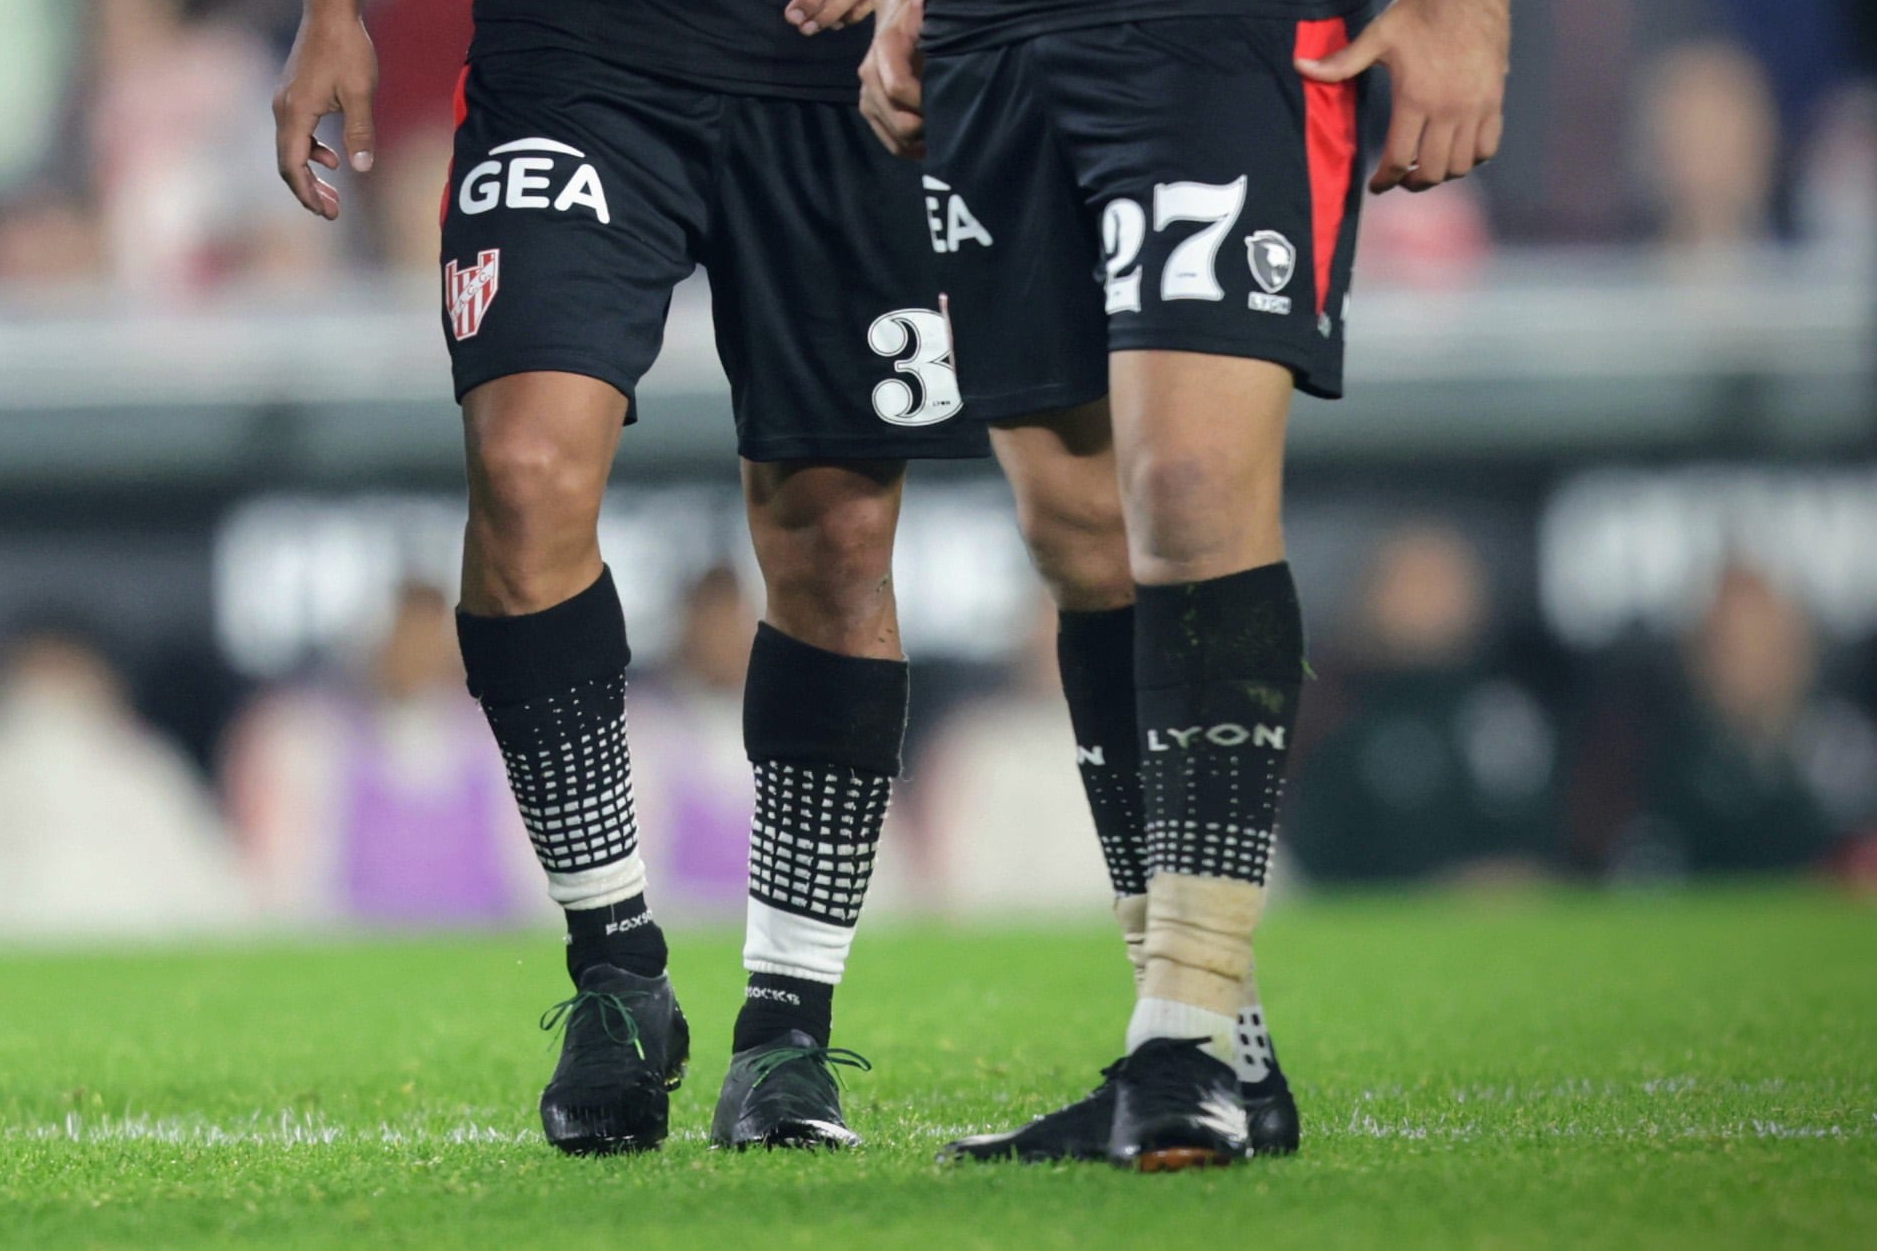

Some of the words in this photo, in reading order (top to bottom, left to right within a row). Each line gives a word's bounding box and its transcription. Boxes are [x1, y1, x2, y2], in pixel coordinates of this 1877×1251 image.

[458, 157, 611, 225] GEA
[1102, 174, 1248, 316] 27
[867, 307, 964, 427] 3
[1147, 723, 1286, 752] LYON
